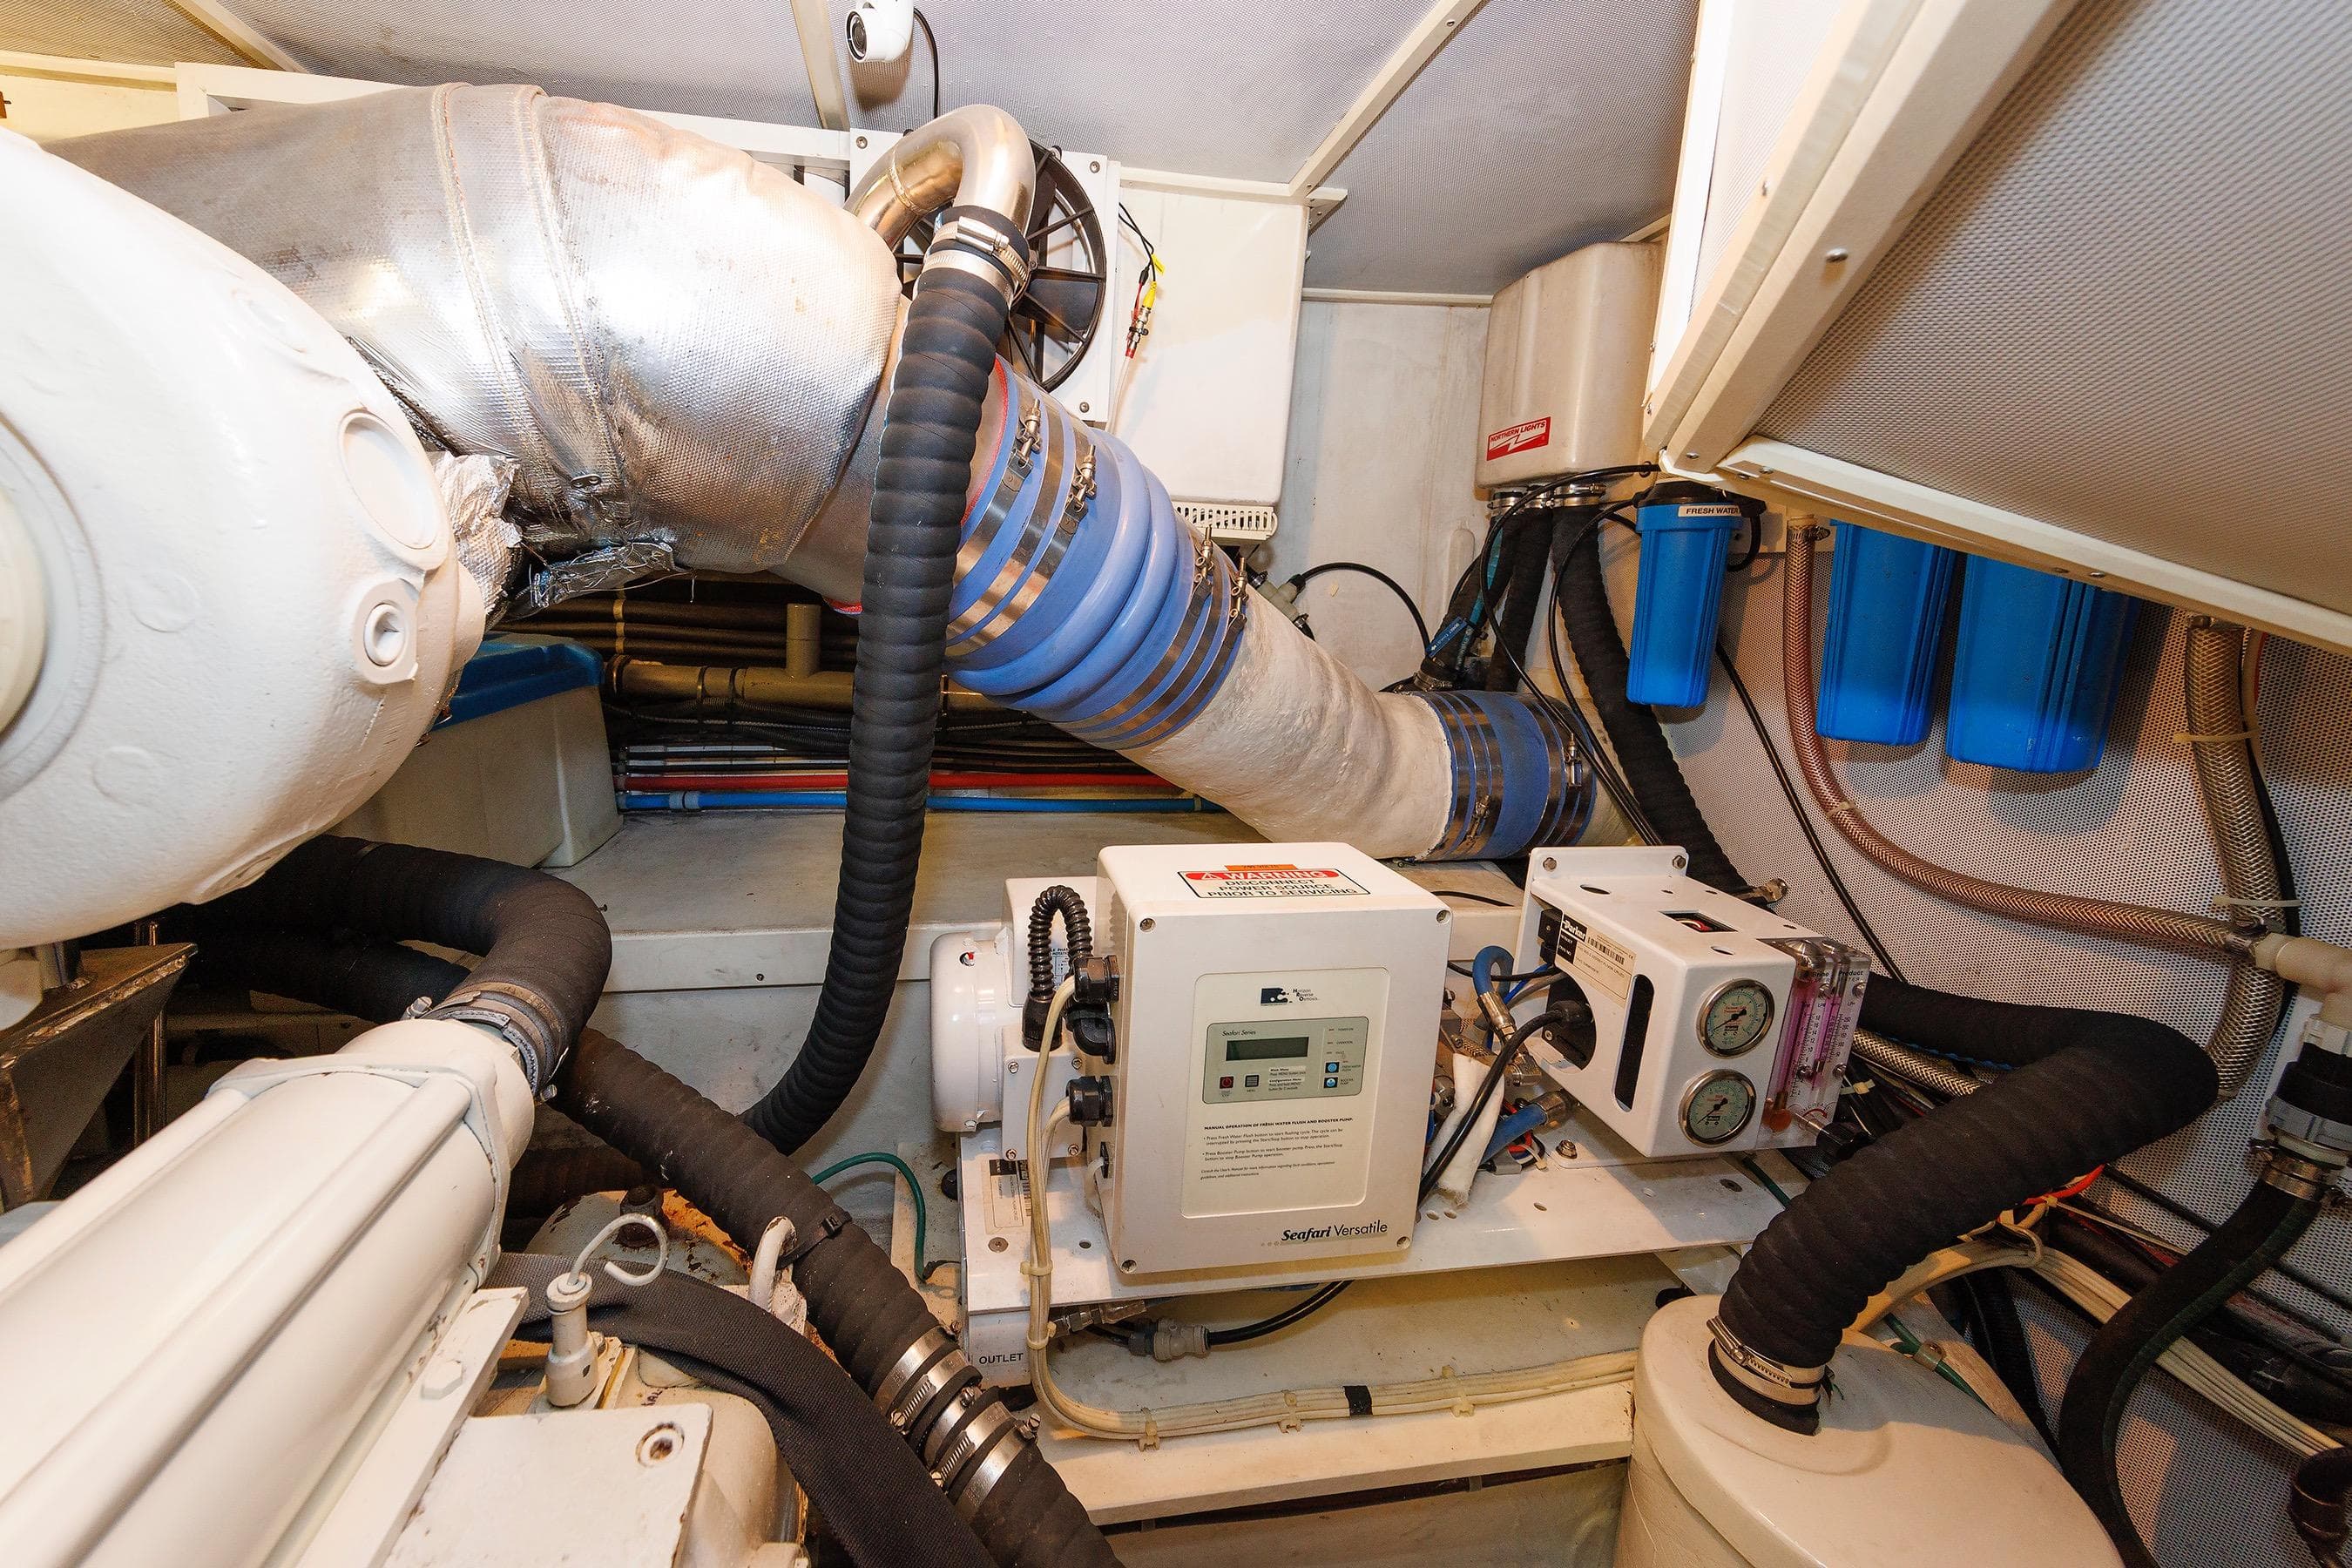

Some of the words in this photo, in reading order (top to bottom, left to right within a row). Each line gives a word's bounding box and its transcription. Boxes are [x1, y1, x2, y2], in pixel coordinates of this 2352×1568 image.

[1490, 428, 1520, 442] NORTHERN
[1520, 421, 1546, 433] LIGHTS
[1223, 871, 1327, 880] WARNING
[1564, 920, 1586, 940] Parker
[1281, 1226, 1331, 1242] Seafari
[1334, 1219, 1387, 1236] Versatile
[979, 1353, 1024, 1364] OUTLET
